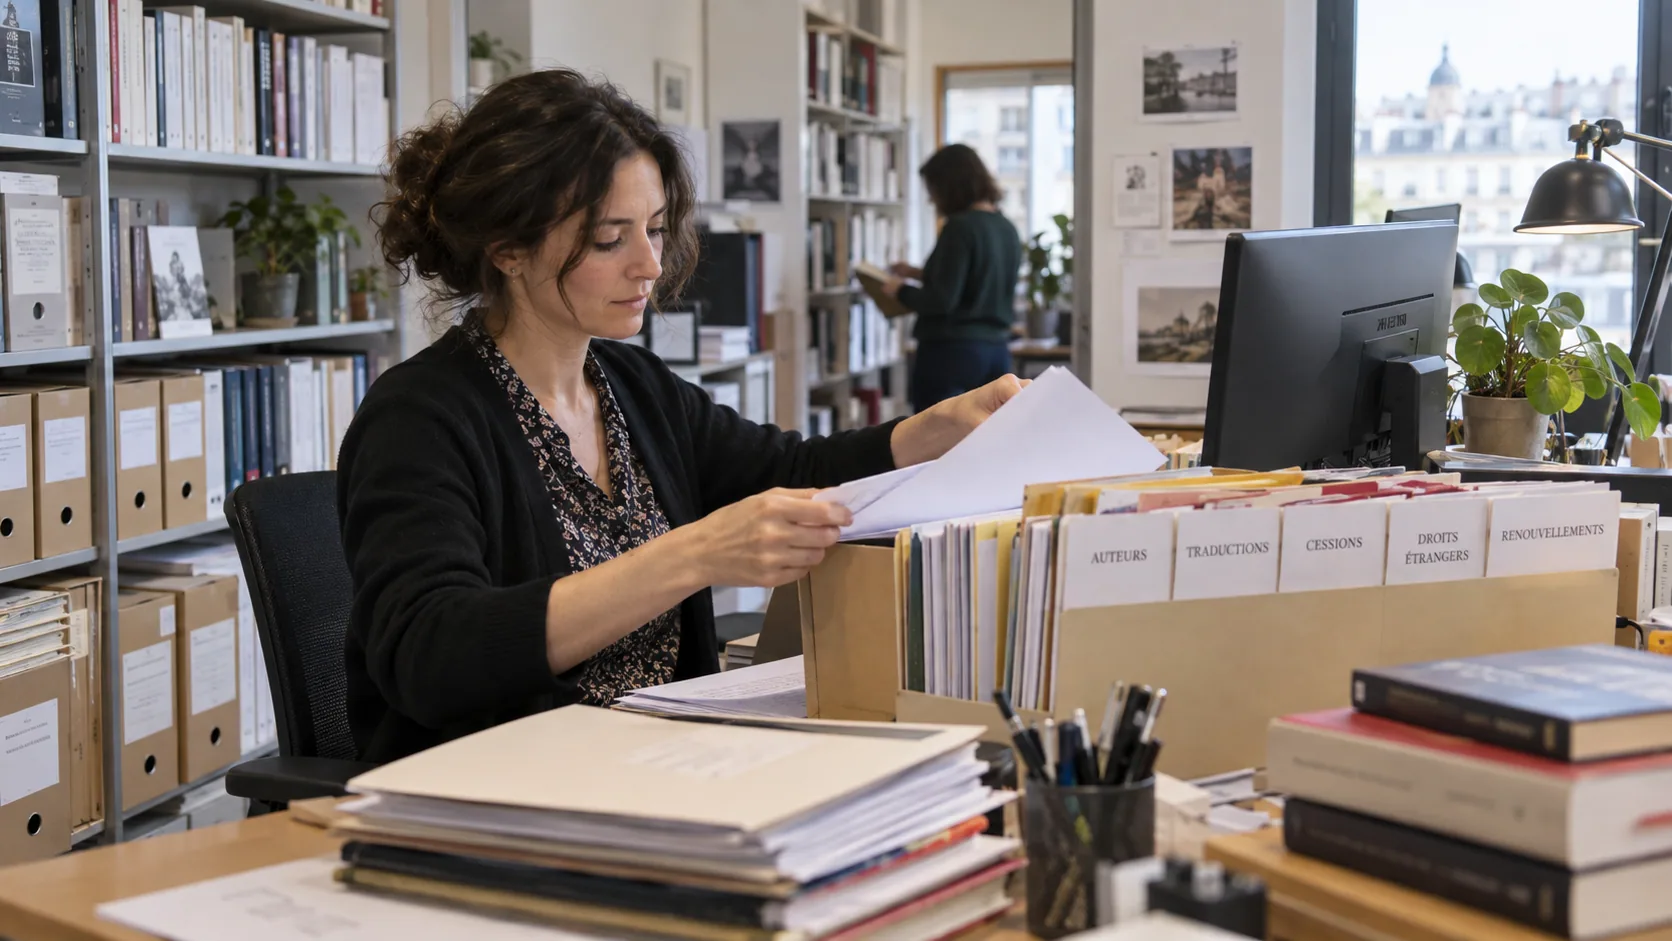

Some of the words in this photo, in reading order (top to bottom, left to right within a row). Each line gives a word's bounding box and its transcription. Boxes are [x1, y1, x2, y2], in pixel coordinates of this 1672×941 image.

[1417, 531, 1459, 545] DROITS
[1501, 524, 1604, 542] RENOUVELLEMENTS
[1186, 542, 1270, 558] TRADUCTIONS
[1306, 536, 1363, 551] CESSIONS
[1091, 549, 1148, 564] AUTEURS
[1405, 549, 1469, 565] ÉTRANGERS
